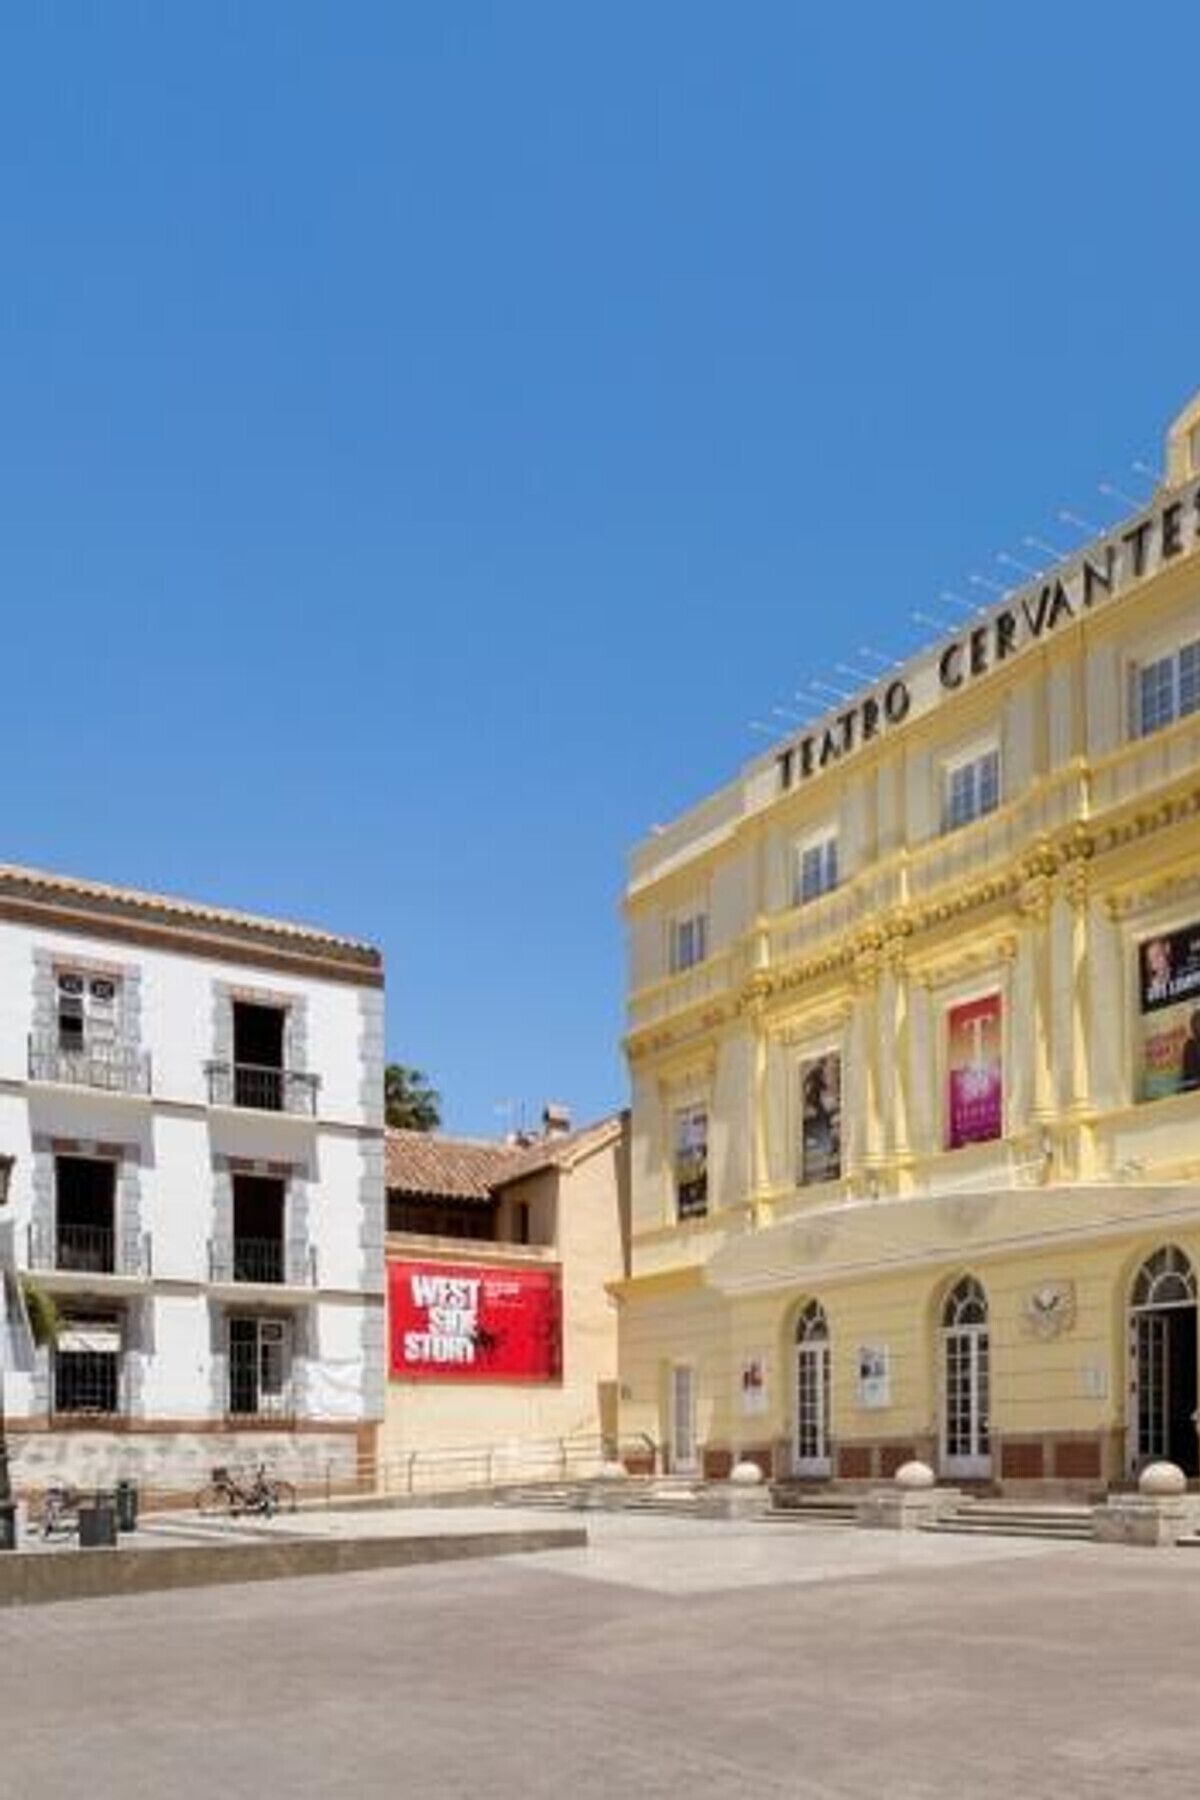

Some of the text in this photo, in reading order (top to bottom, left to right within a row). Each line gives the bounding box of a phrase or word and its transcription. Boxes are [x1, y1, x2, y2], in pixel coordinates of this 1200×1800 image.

[775, 682, 911, 790] TEATRO
[411, 1275, 481, 1308] WEST
[428, 1306, 478, 1336] SIDE
[404, 1331, 476, 1364] STORY
